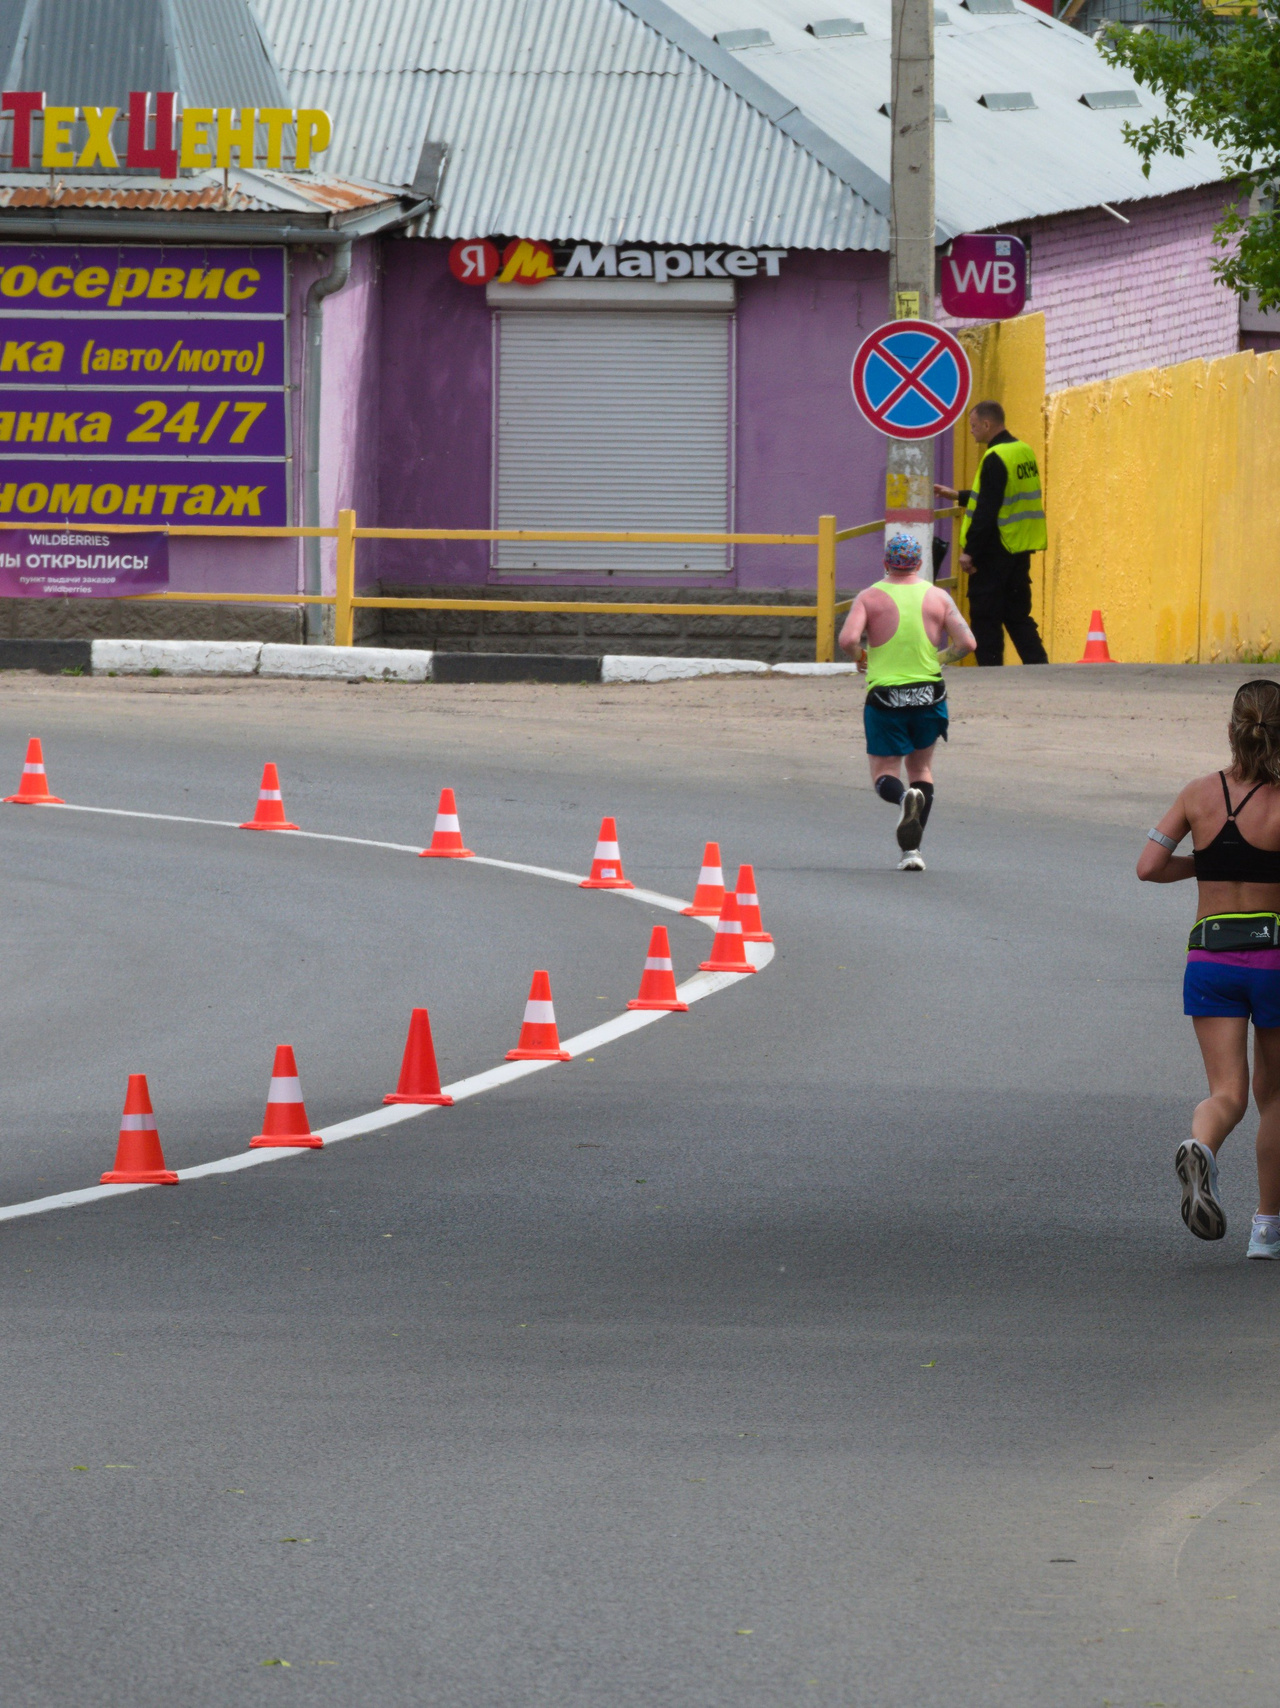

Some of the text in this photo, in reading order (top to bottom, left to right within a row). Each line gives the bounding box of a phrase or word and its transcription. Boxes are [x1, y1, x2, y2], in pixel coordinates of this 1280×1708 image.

[563, 245, 788, 282] Маркет
[950, 259, 1017, 294] WB
[0, 265, 261, 307] осервис
[0, 340, 264, 376] ка (авто/мото)
[126, 400, 267, 444] 24/7
[29, 534, 110, 547] WILDBERRIES
[26, 554, 149, 569] ОТКРЫЛИСЬ!
[43, 585, 92, 593] Wildberries
